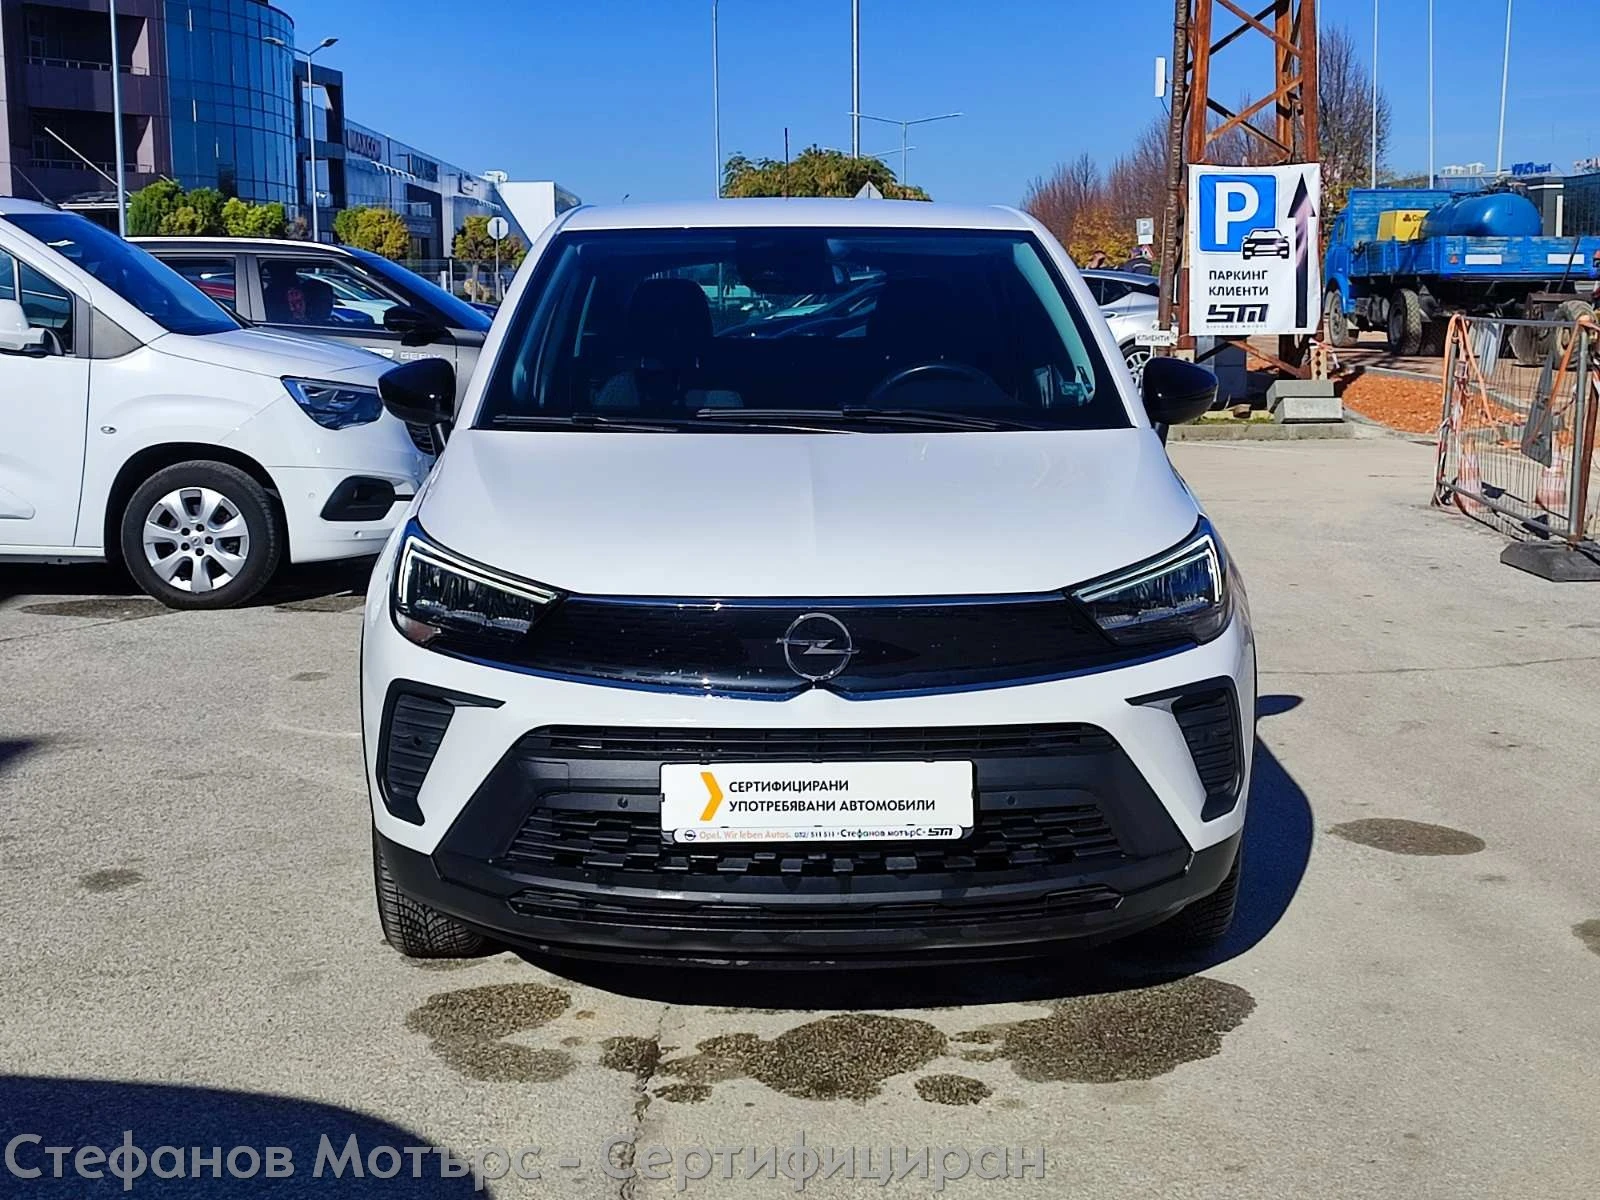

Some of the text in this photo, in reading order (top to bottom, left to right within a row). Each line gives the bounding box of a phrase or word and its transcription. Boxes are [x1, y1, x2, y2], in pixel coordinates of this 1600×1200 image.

[1215, 181, 1259, 245] P
[1208, 270, 1269, 280] ПАРКИНГ
[1208, 286, 1269, 296] КЛИЕНТИ
[729, 780, 849, 793] СЕРТИФИЦИРАНИ
[729, 799, 936, 812] УПОТРЕБЯВАНИ АВТОМОБИЛИ
